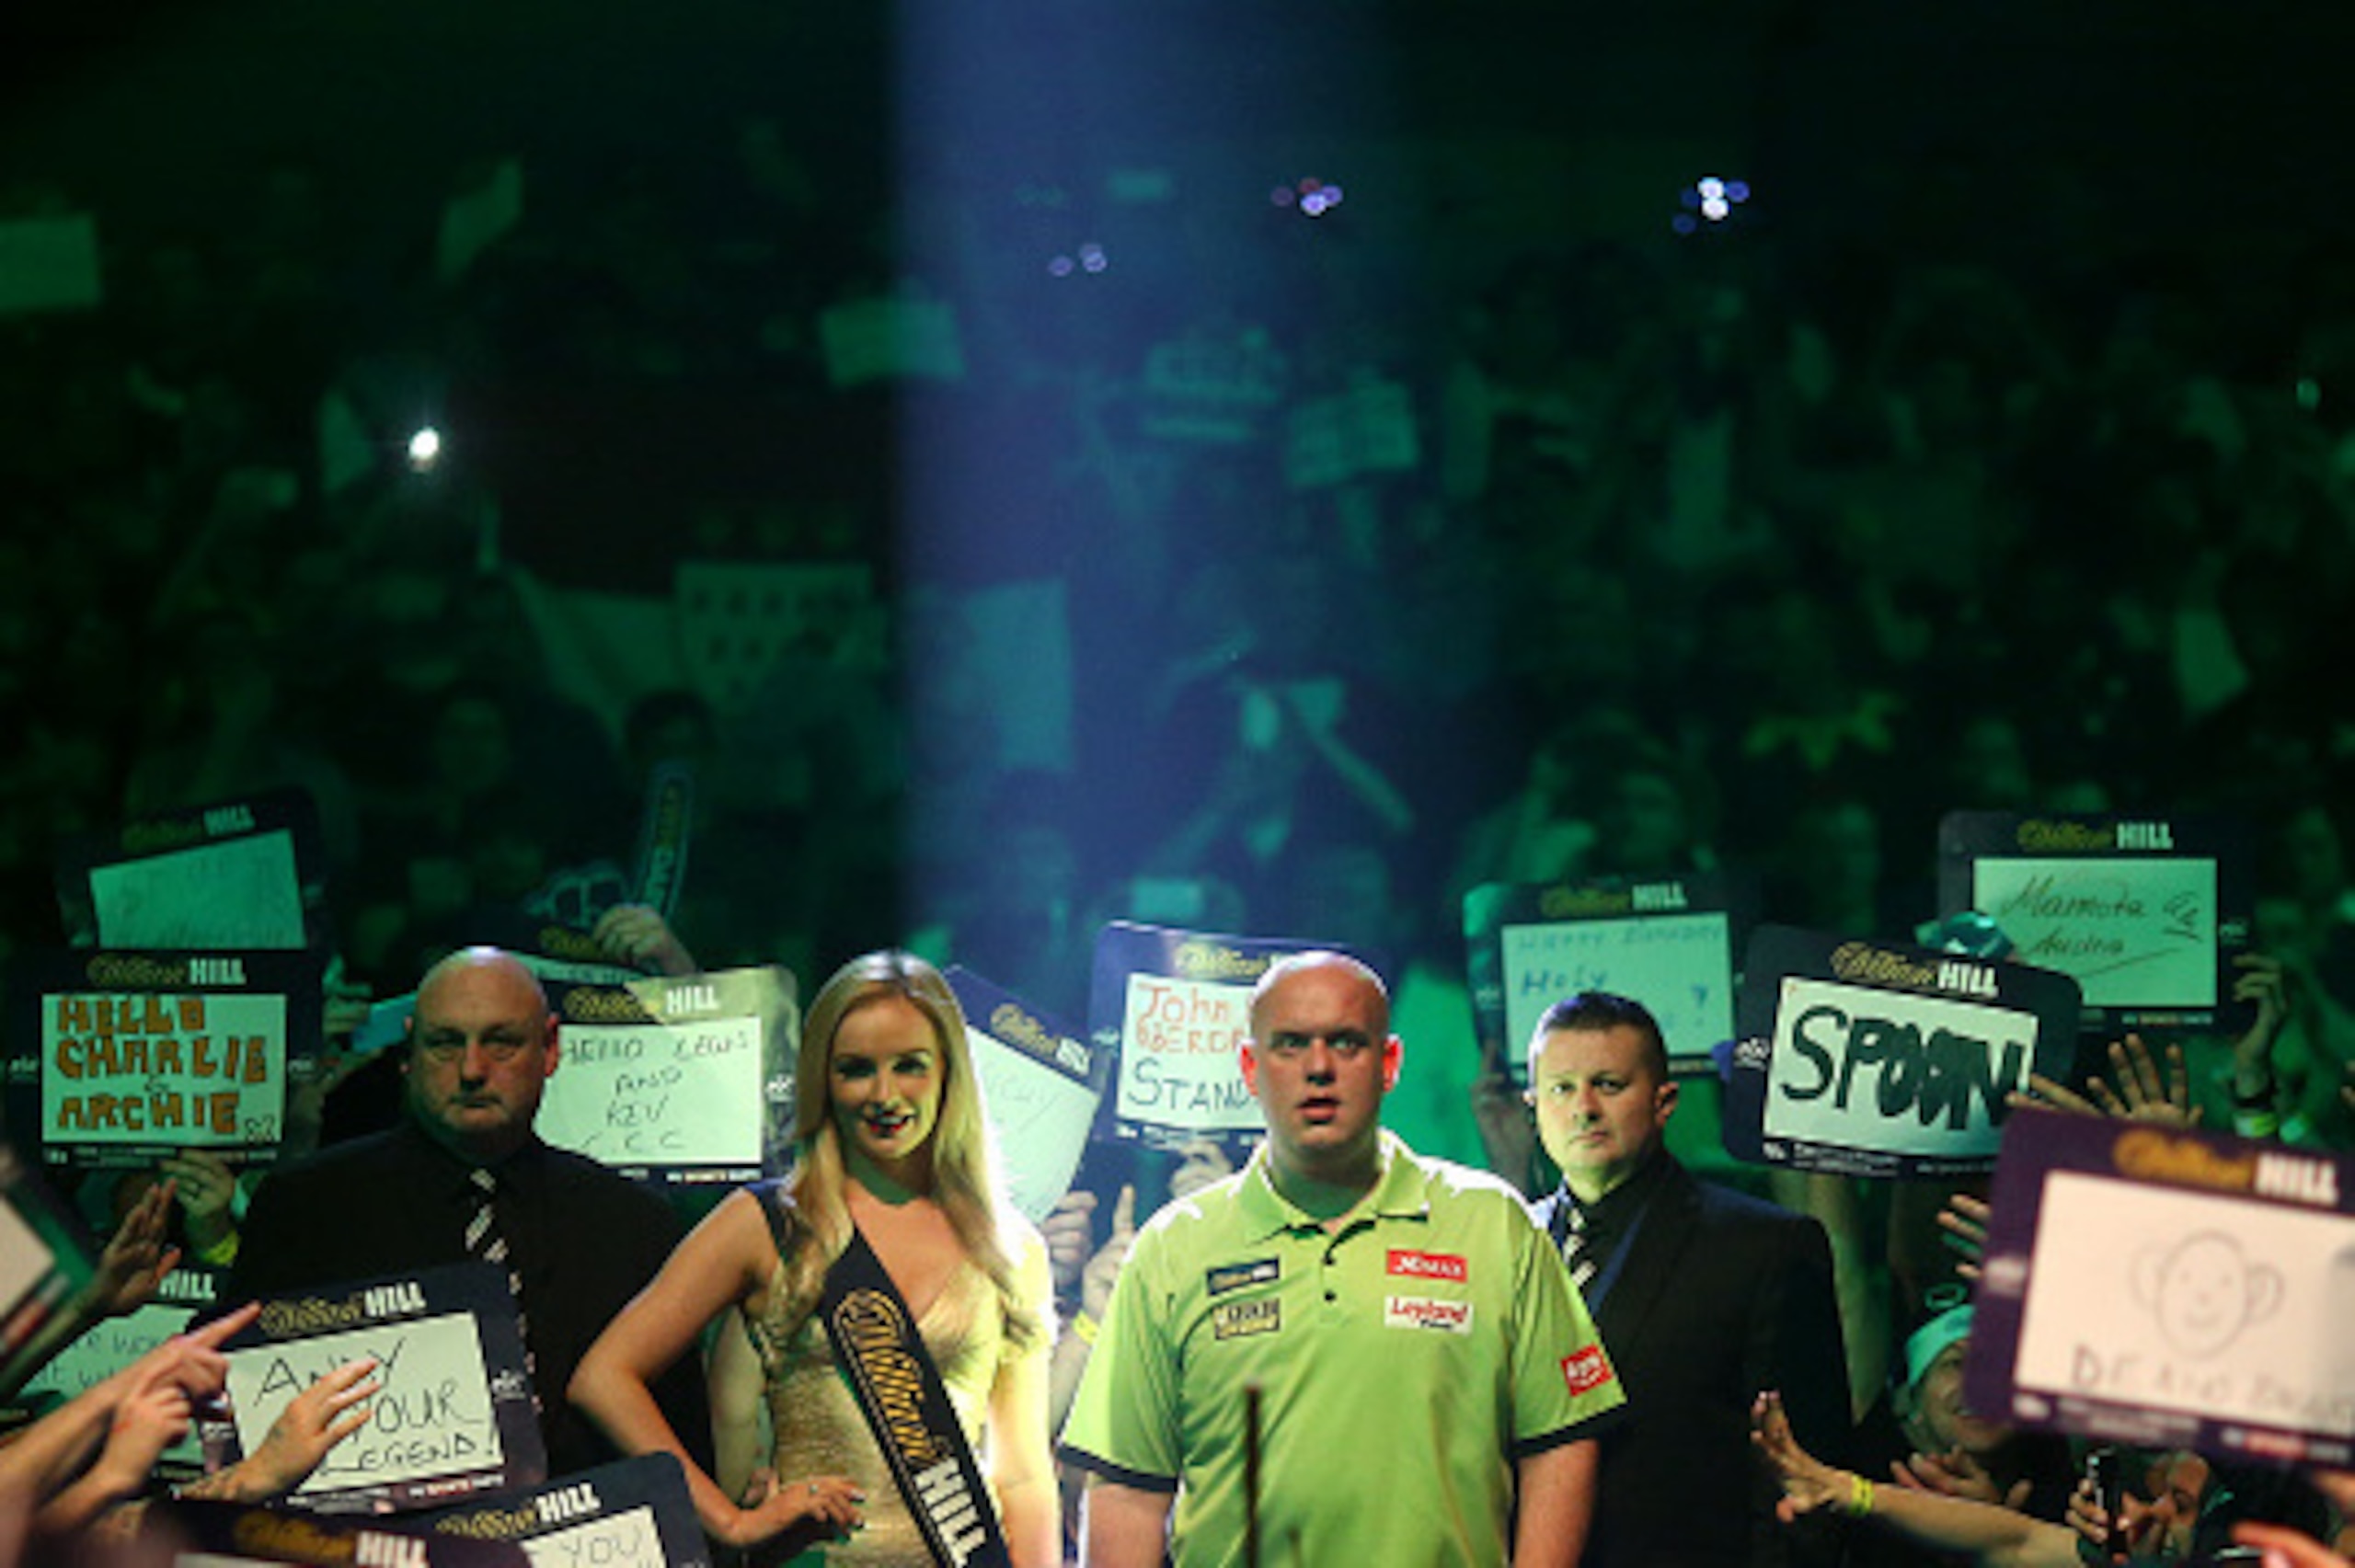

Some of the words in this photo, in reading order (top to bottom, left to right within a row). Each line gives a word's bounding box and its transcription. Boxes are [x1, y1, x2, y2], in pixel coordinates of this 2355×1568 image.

[2118, 822, 2174, 851] HILL
[189, 958, 247, 986] HILL
[1937, 961, 2000, 998] HILL
[57, 996, 205, 1036] HELLO
[665, 985, 720, 1015] HILL
[56, 1036, 266, 1083] CHARLIE
[1779, 1005, 2024, 1131] SPOON
[57, 1093, 239, 1134] ARCHIE
[2256, 1152, 2338, 1207] HILL
[159, 1271, 217, 1299] HILL
[365, 1282, 427, 1317] HILL
[535, 1482, 601, 1523] HILL
[914, 1457, 987, 1568] HILL
[355, 1529, 431, 1568] HILL
